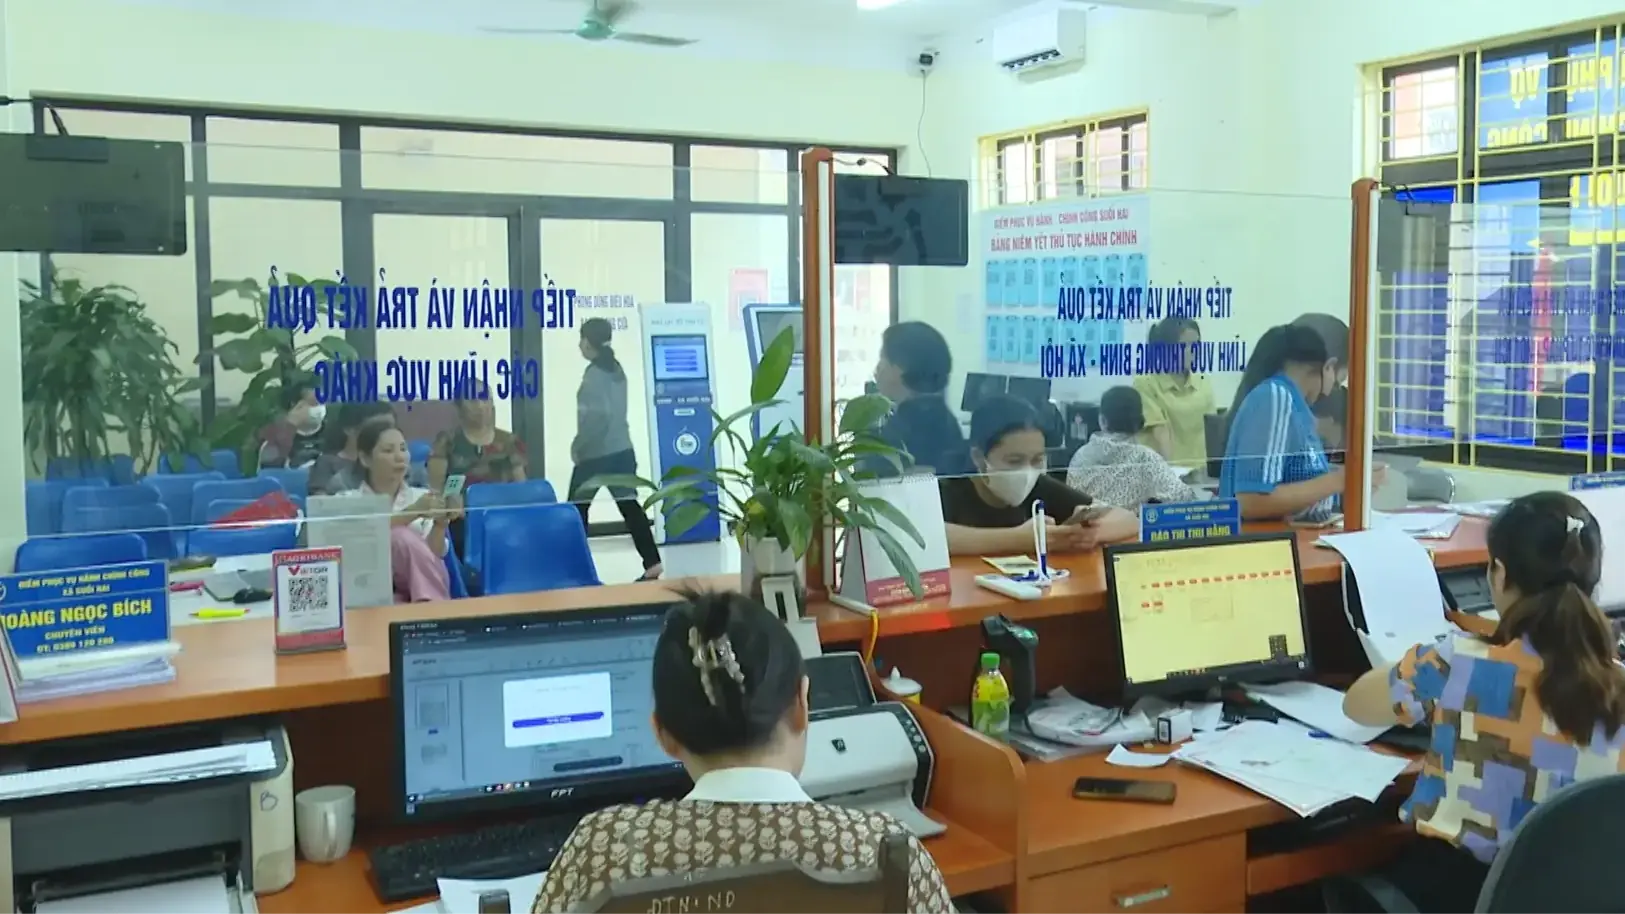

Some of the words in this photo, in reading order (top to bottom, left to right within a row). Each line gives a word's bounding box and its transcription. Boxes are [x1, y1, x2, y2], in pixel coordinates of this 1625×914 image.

[60, 603, 108, 625] NGỌC
[113, 597, 152, 617] BÍCH
[550, 788, 575, 799] FPT
